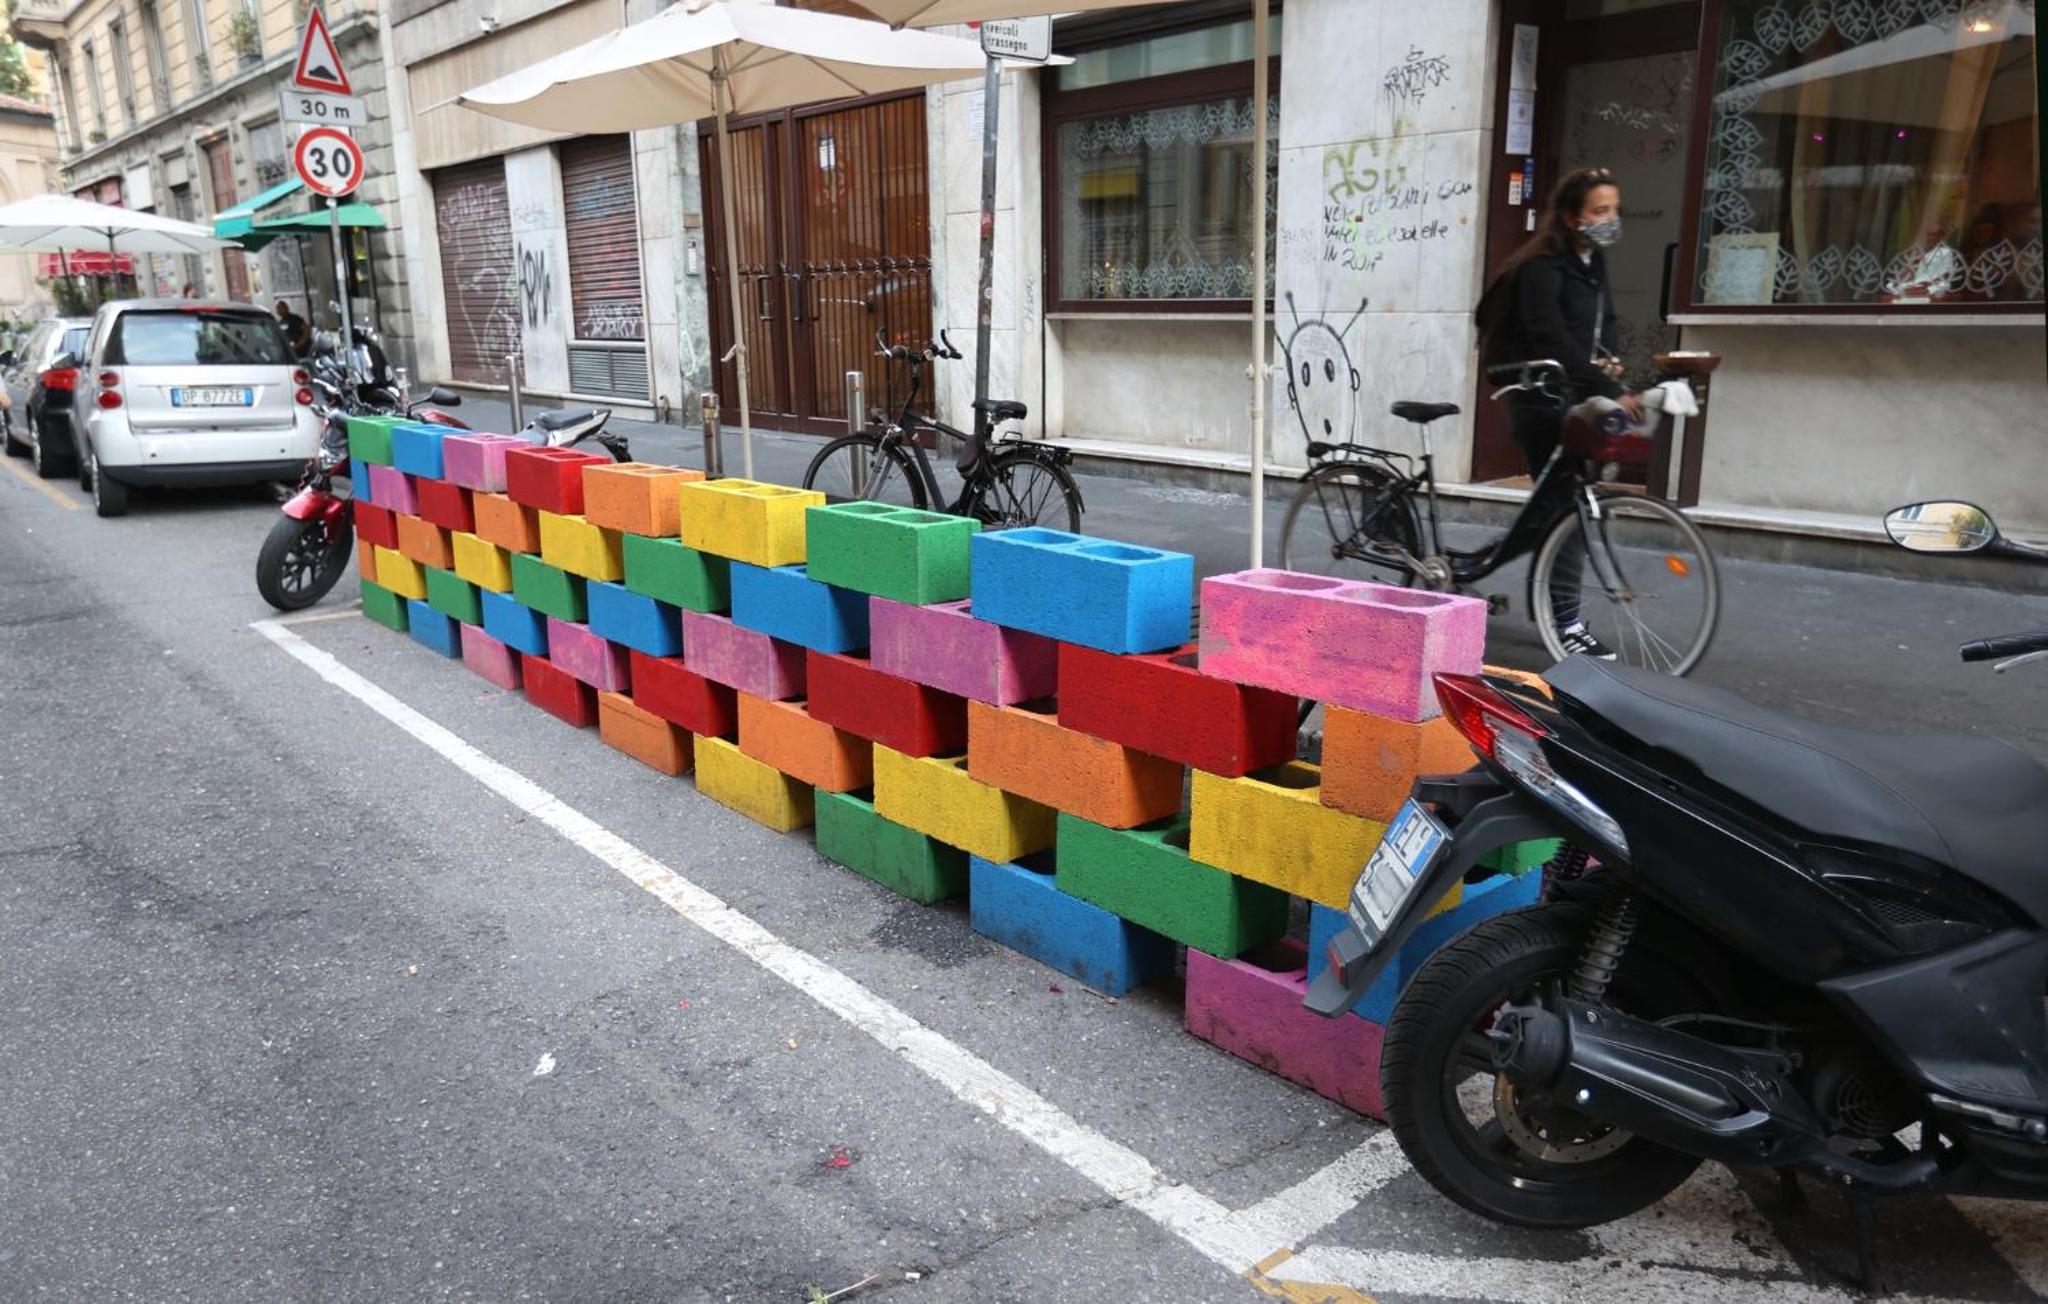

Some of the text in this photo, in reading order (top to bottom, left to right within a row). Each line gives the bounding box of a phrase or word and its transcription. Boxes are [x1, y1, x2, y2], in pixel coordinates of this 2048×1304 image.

[301, 99, 349, 118] 30 m
[309, 148, 351, 177] 30
